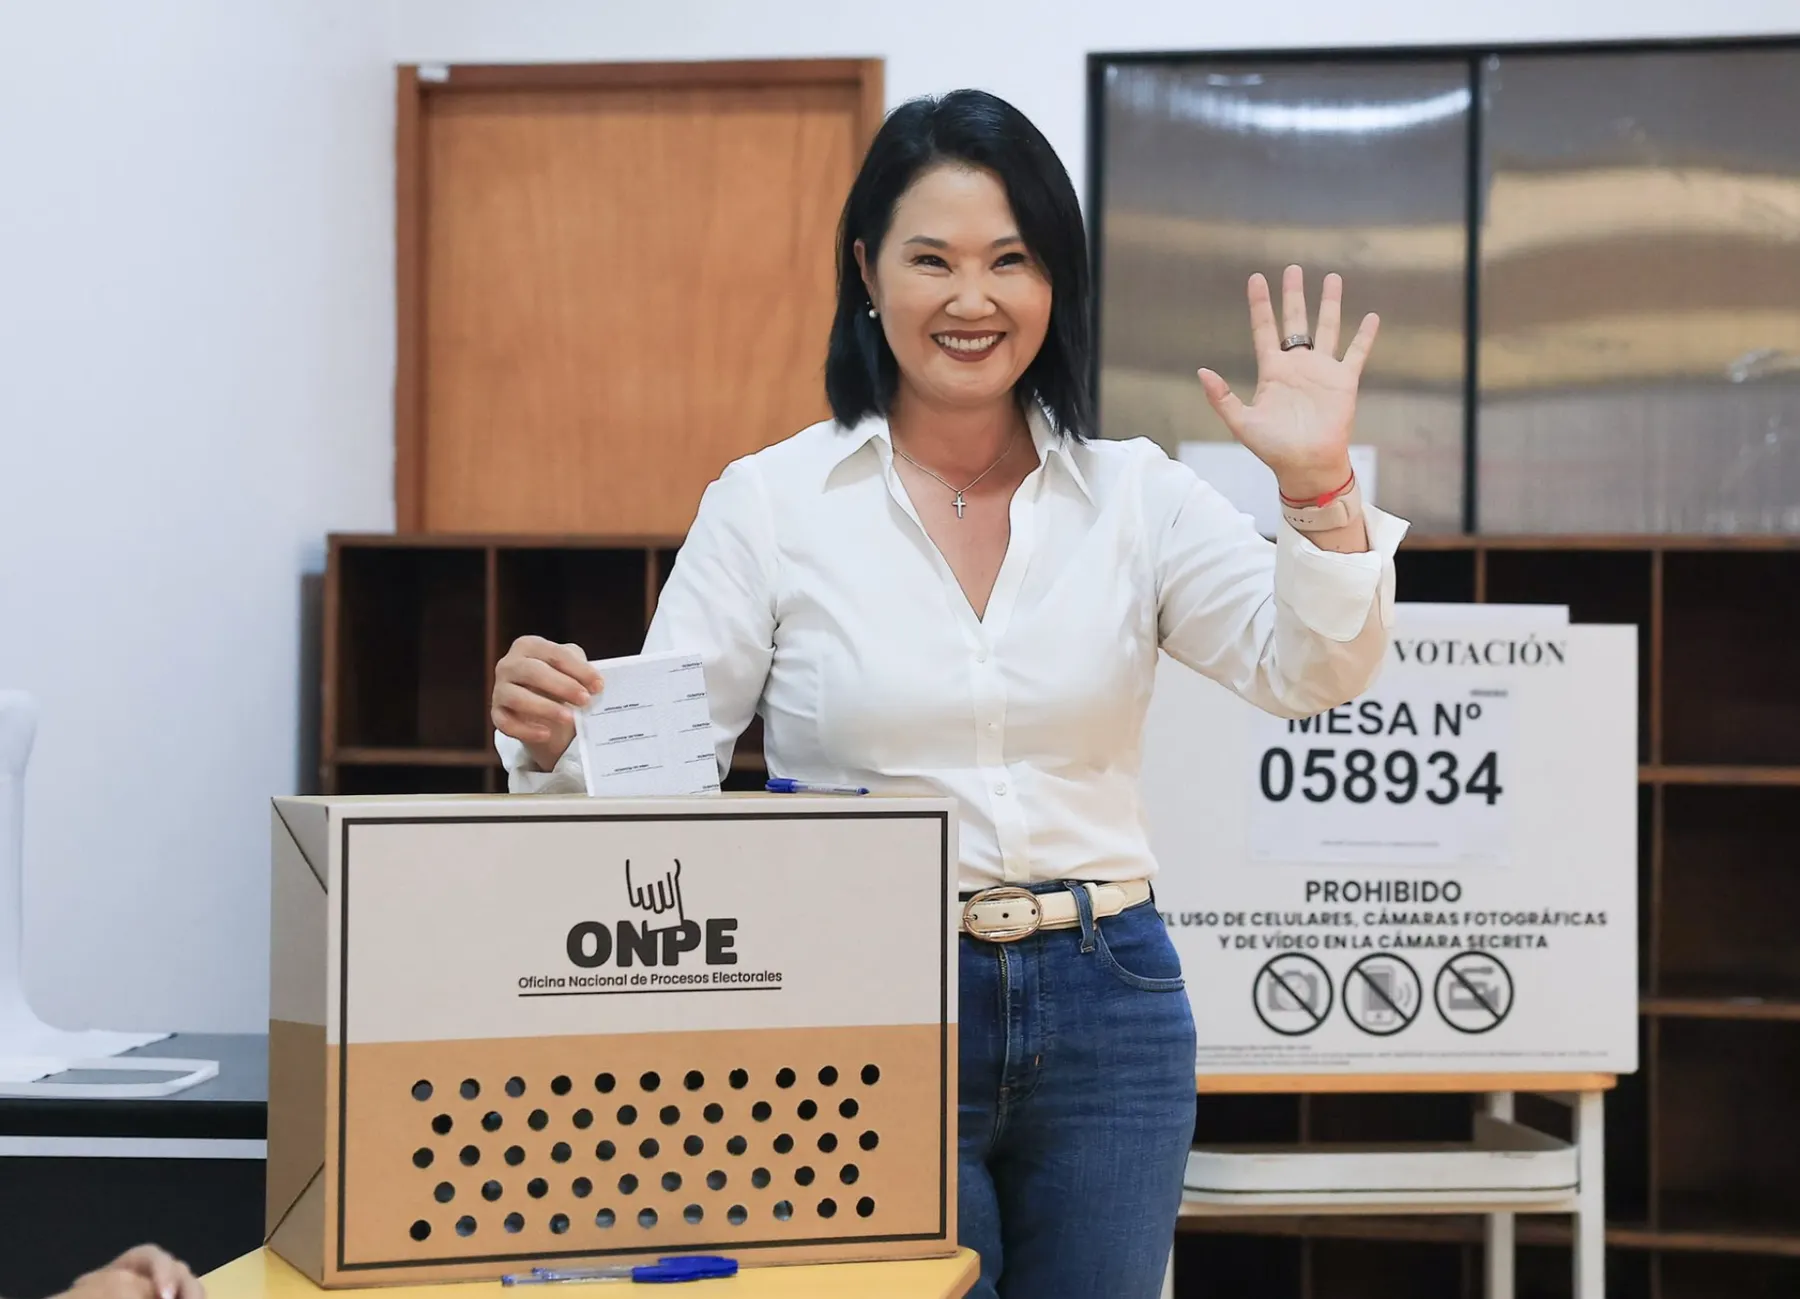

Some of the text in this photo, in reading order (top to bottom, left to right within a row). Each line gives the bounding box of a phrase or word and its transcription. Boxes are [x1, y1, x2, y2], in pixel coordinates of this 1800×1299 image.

[1393, 633, 1567, 666] VOTACIÓN
[1259, 746, 1504, 806] 058934
[1305, 880, 1463, 903] PROHIBIDO
[1159, 907, 1608, 928] L USO DE CELULARES, CÁMARAS FOTOGRÁFICAS
[566, 918, 738, 968] ONPE
[1218, 930, 1549, 951] Y DE VÍDEO EN LA CÁMARA SECRETA
[518, 970, 782, 989] Oficina Nacional de Procesos Electorales
